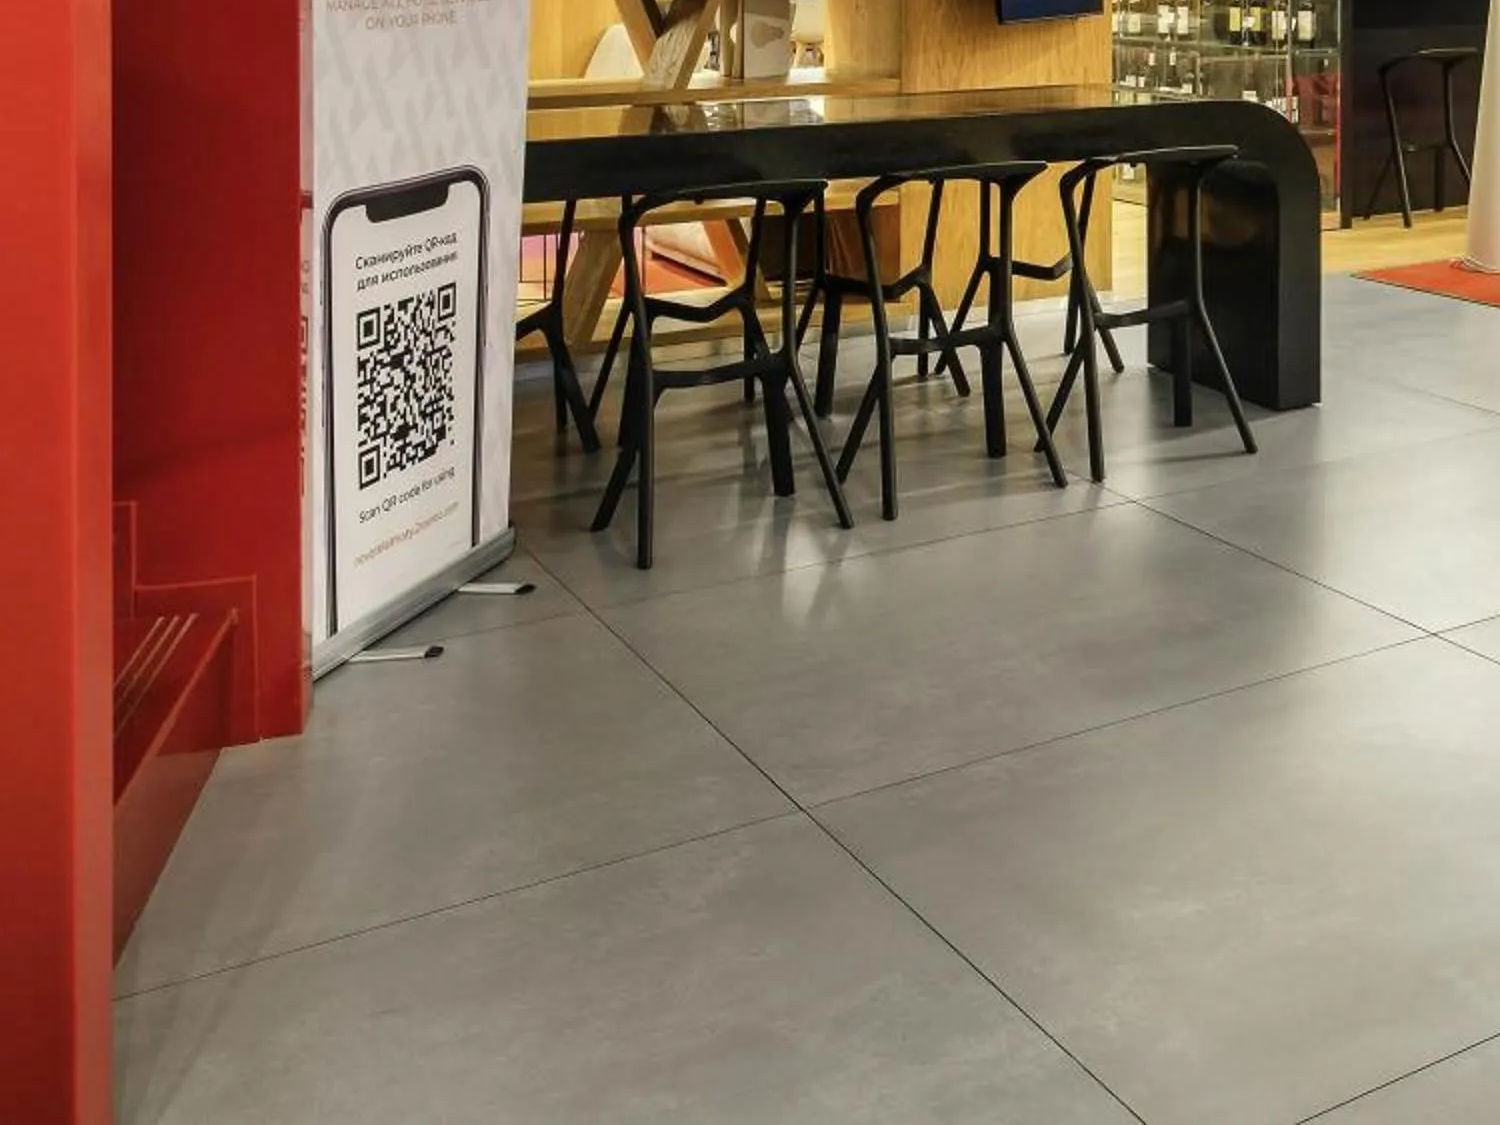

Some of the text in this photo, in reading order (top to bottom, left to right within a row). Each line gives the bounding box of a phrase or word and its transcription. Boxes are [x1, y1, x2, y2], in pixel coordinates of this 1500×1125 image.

[365, 16, 385, 31] ON
[355, 243, 422, 270] Сканируйте
[357, 274, 379, 291] для
[359, 466, 455, 524] Scan QR code for using
